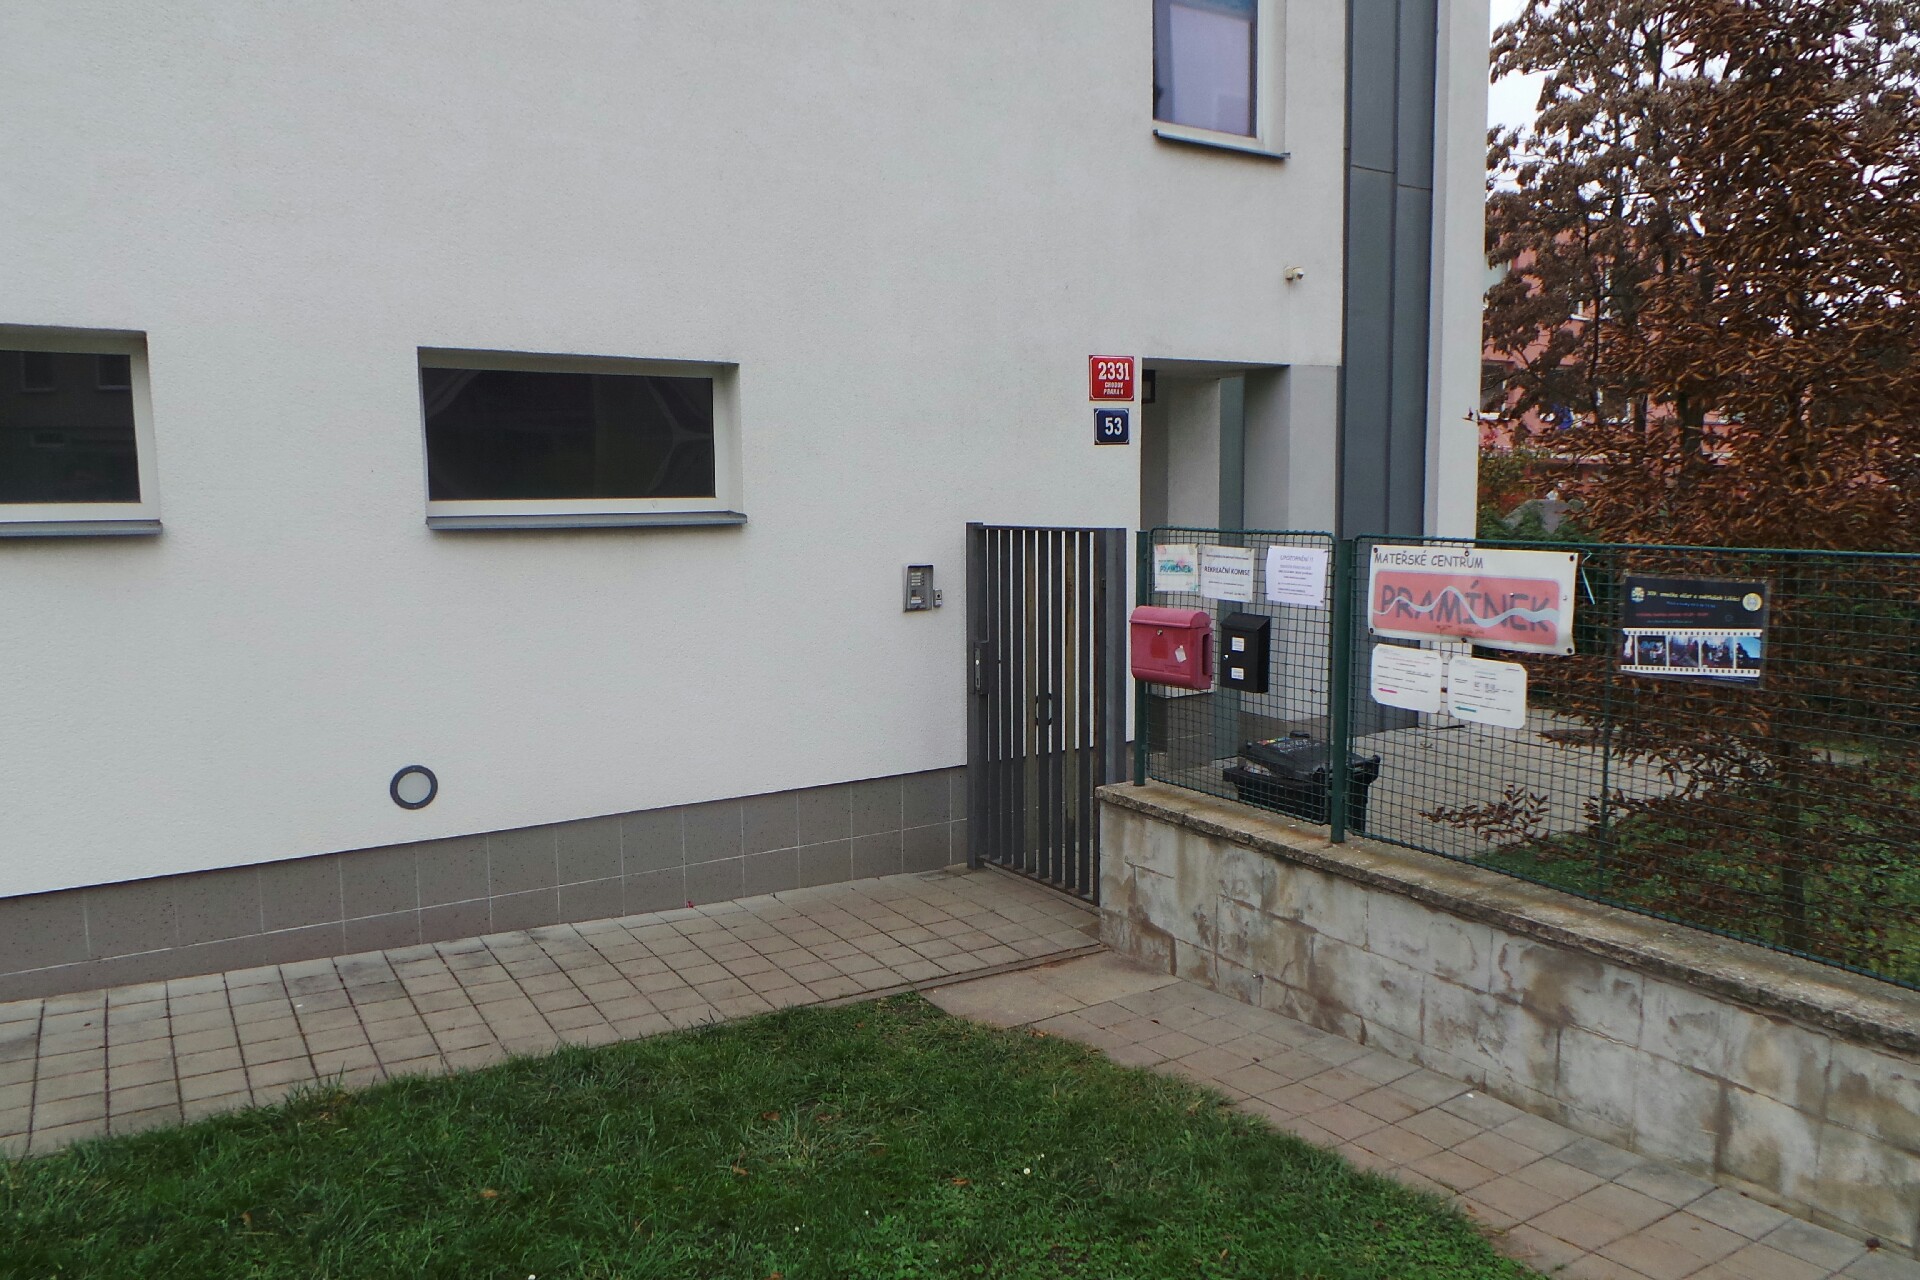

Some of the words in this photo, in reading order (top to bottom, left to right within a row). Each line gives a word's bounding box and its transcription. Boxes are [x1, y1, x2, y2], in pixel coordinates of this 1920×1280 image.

[1098, 361, 1130, 381] 2331
[1104, 416, 1122, 436] 53
[1374, 549, 1426, 566] MATEŘSKÉ
[1431, 554, 1484, 569] CENTRUM
[1381, 580, 1550, 632] PRAMÍNEK
